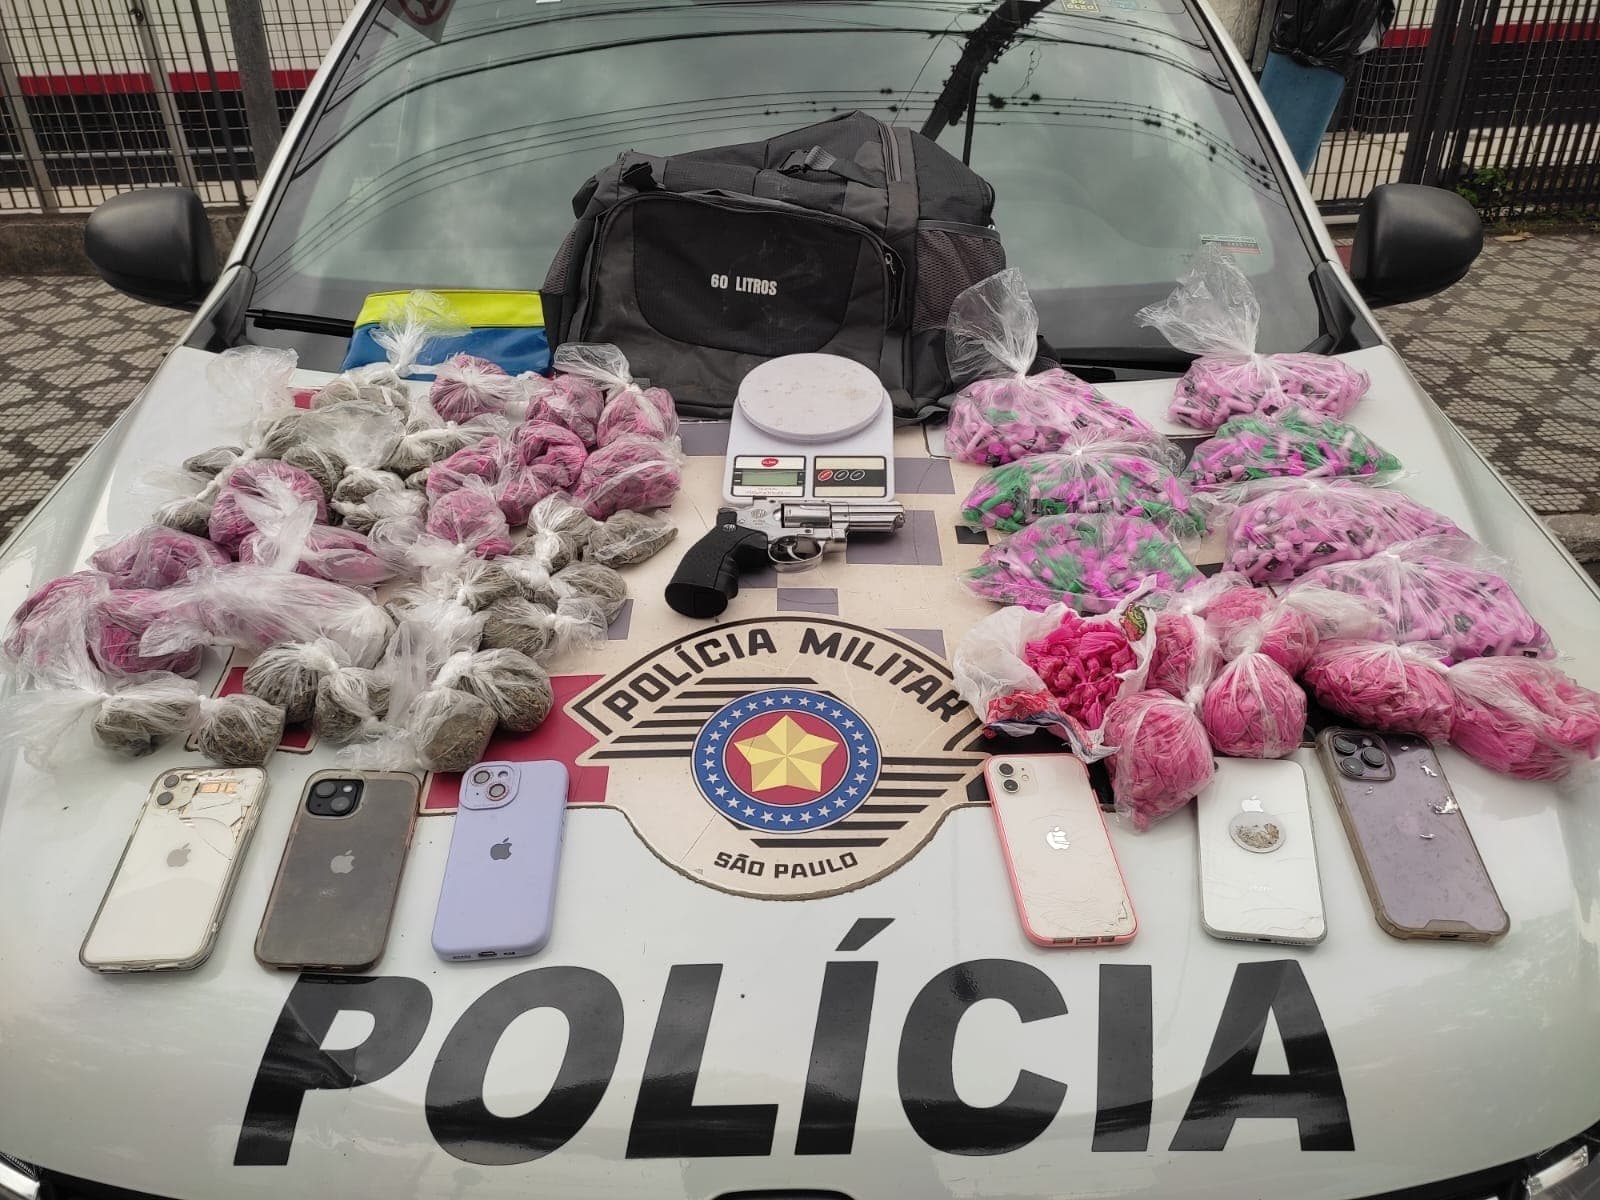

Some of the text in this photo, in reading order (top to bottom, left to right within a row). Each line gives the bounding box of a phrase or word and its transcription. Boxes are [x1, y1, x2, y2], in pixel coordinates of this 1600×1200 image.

[710, 273, 778, 296] 60 LITROS
[602, 627, 970, 723] POLÍCIA MILITAR
[713, 851, 858, 879] SÃO PAULO
[233, 917, 1356, 1166] POLÍCIA
